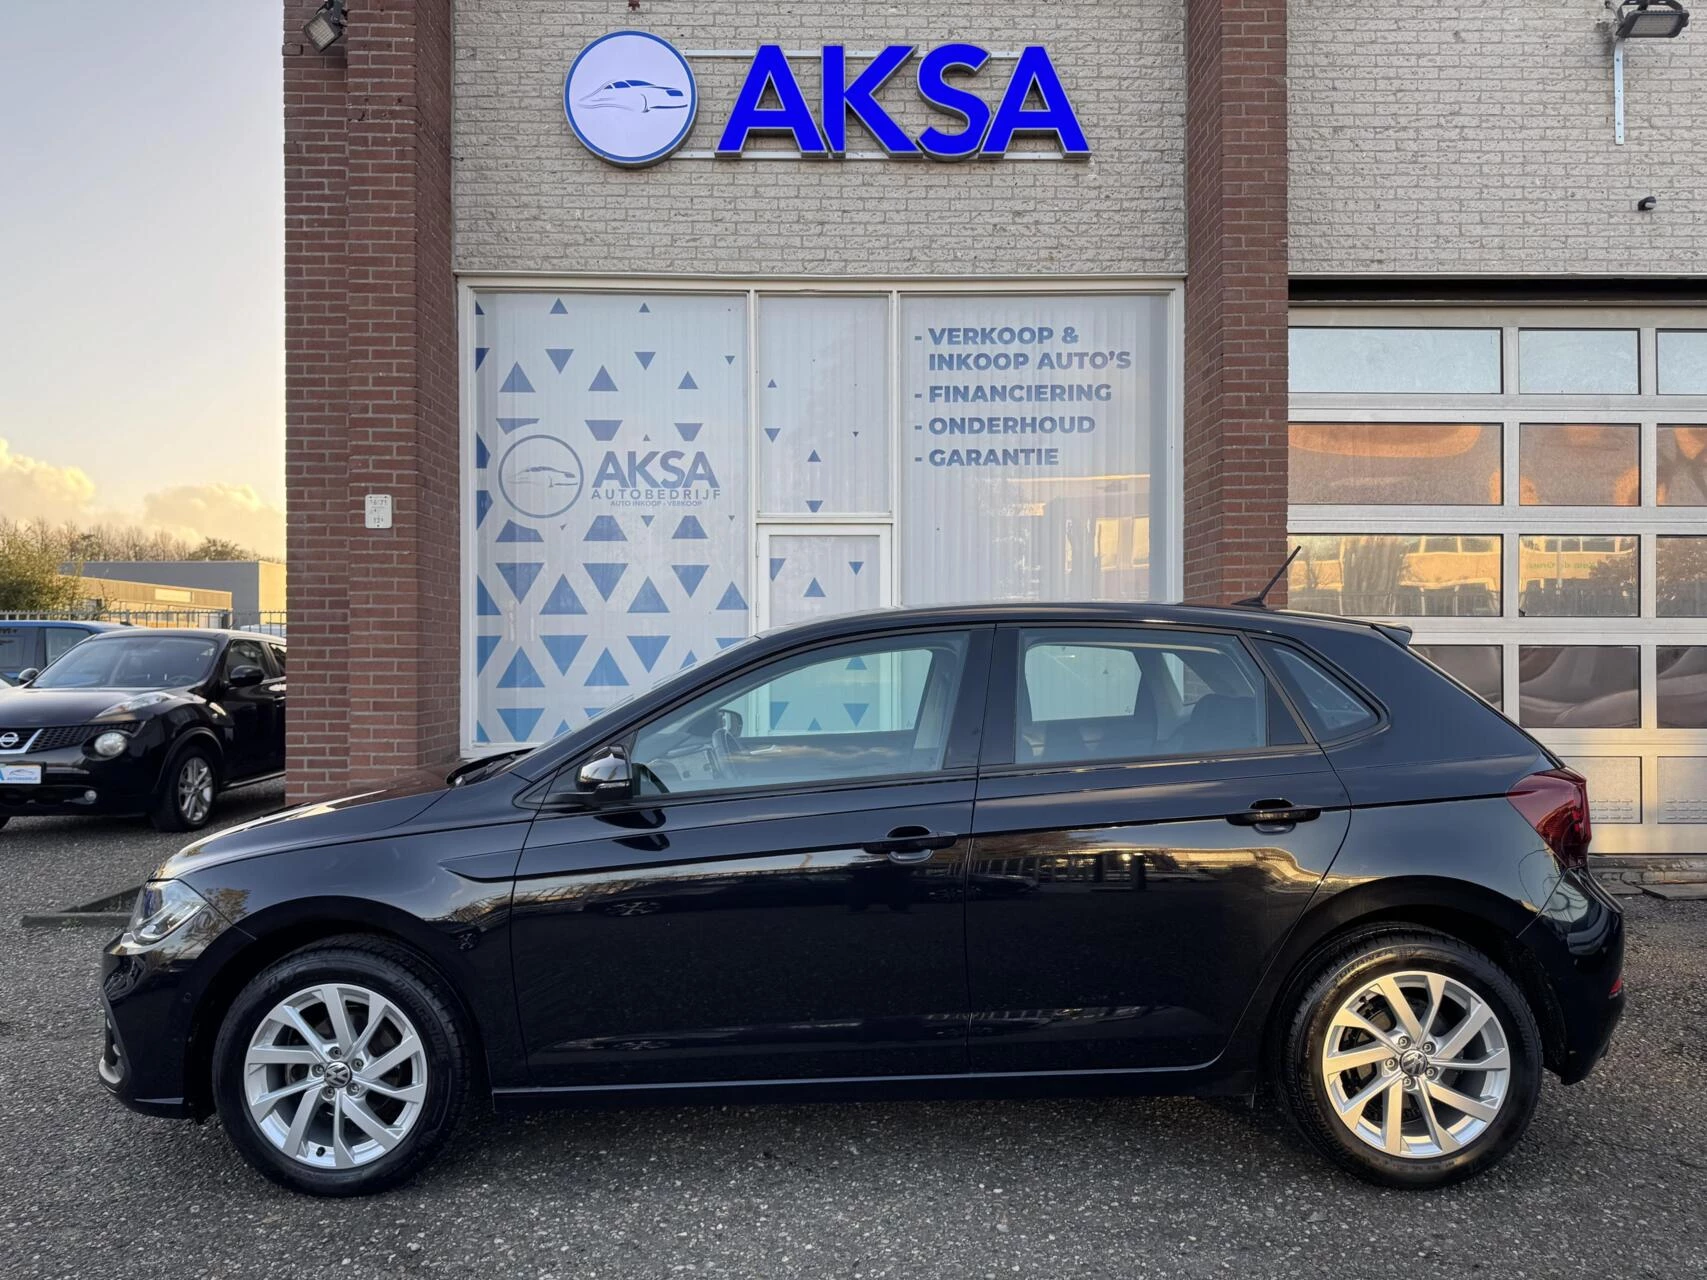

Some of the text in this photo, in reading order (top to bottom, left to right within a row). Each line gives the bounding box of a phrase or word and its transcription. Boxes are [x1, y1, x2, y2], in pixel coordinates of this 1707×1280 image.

[715, 43, 1092, 162] AKSA
[928, 326, 1054, 346] VERKOOP
[1061, 326, 1079, 344] &
[929, 350, 1131, 371] INKOOP AUTO'S
[929, 384, 1112, 403] FINANCIERING
[929, 416, 1096, 435] ONDERHOUD
[929, 448, 1059, 467] GARANTIE
[592, 450, 720, 489] AKSA
[591, 489, 721, 500] AUTOBEDRIJF
